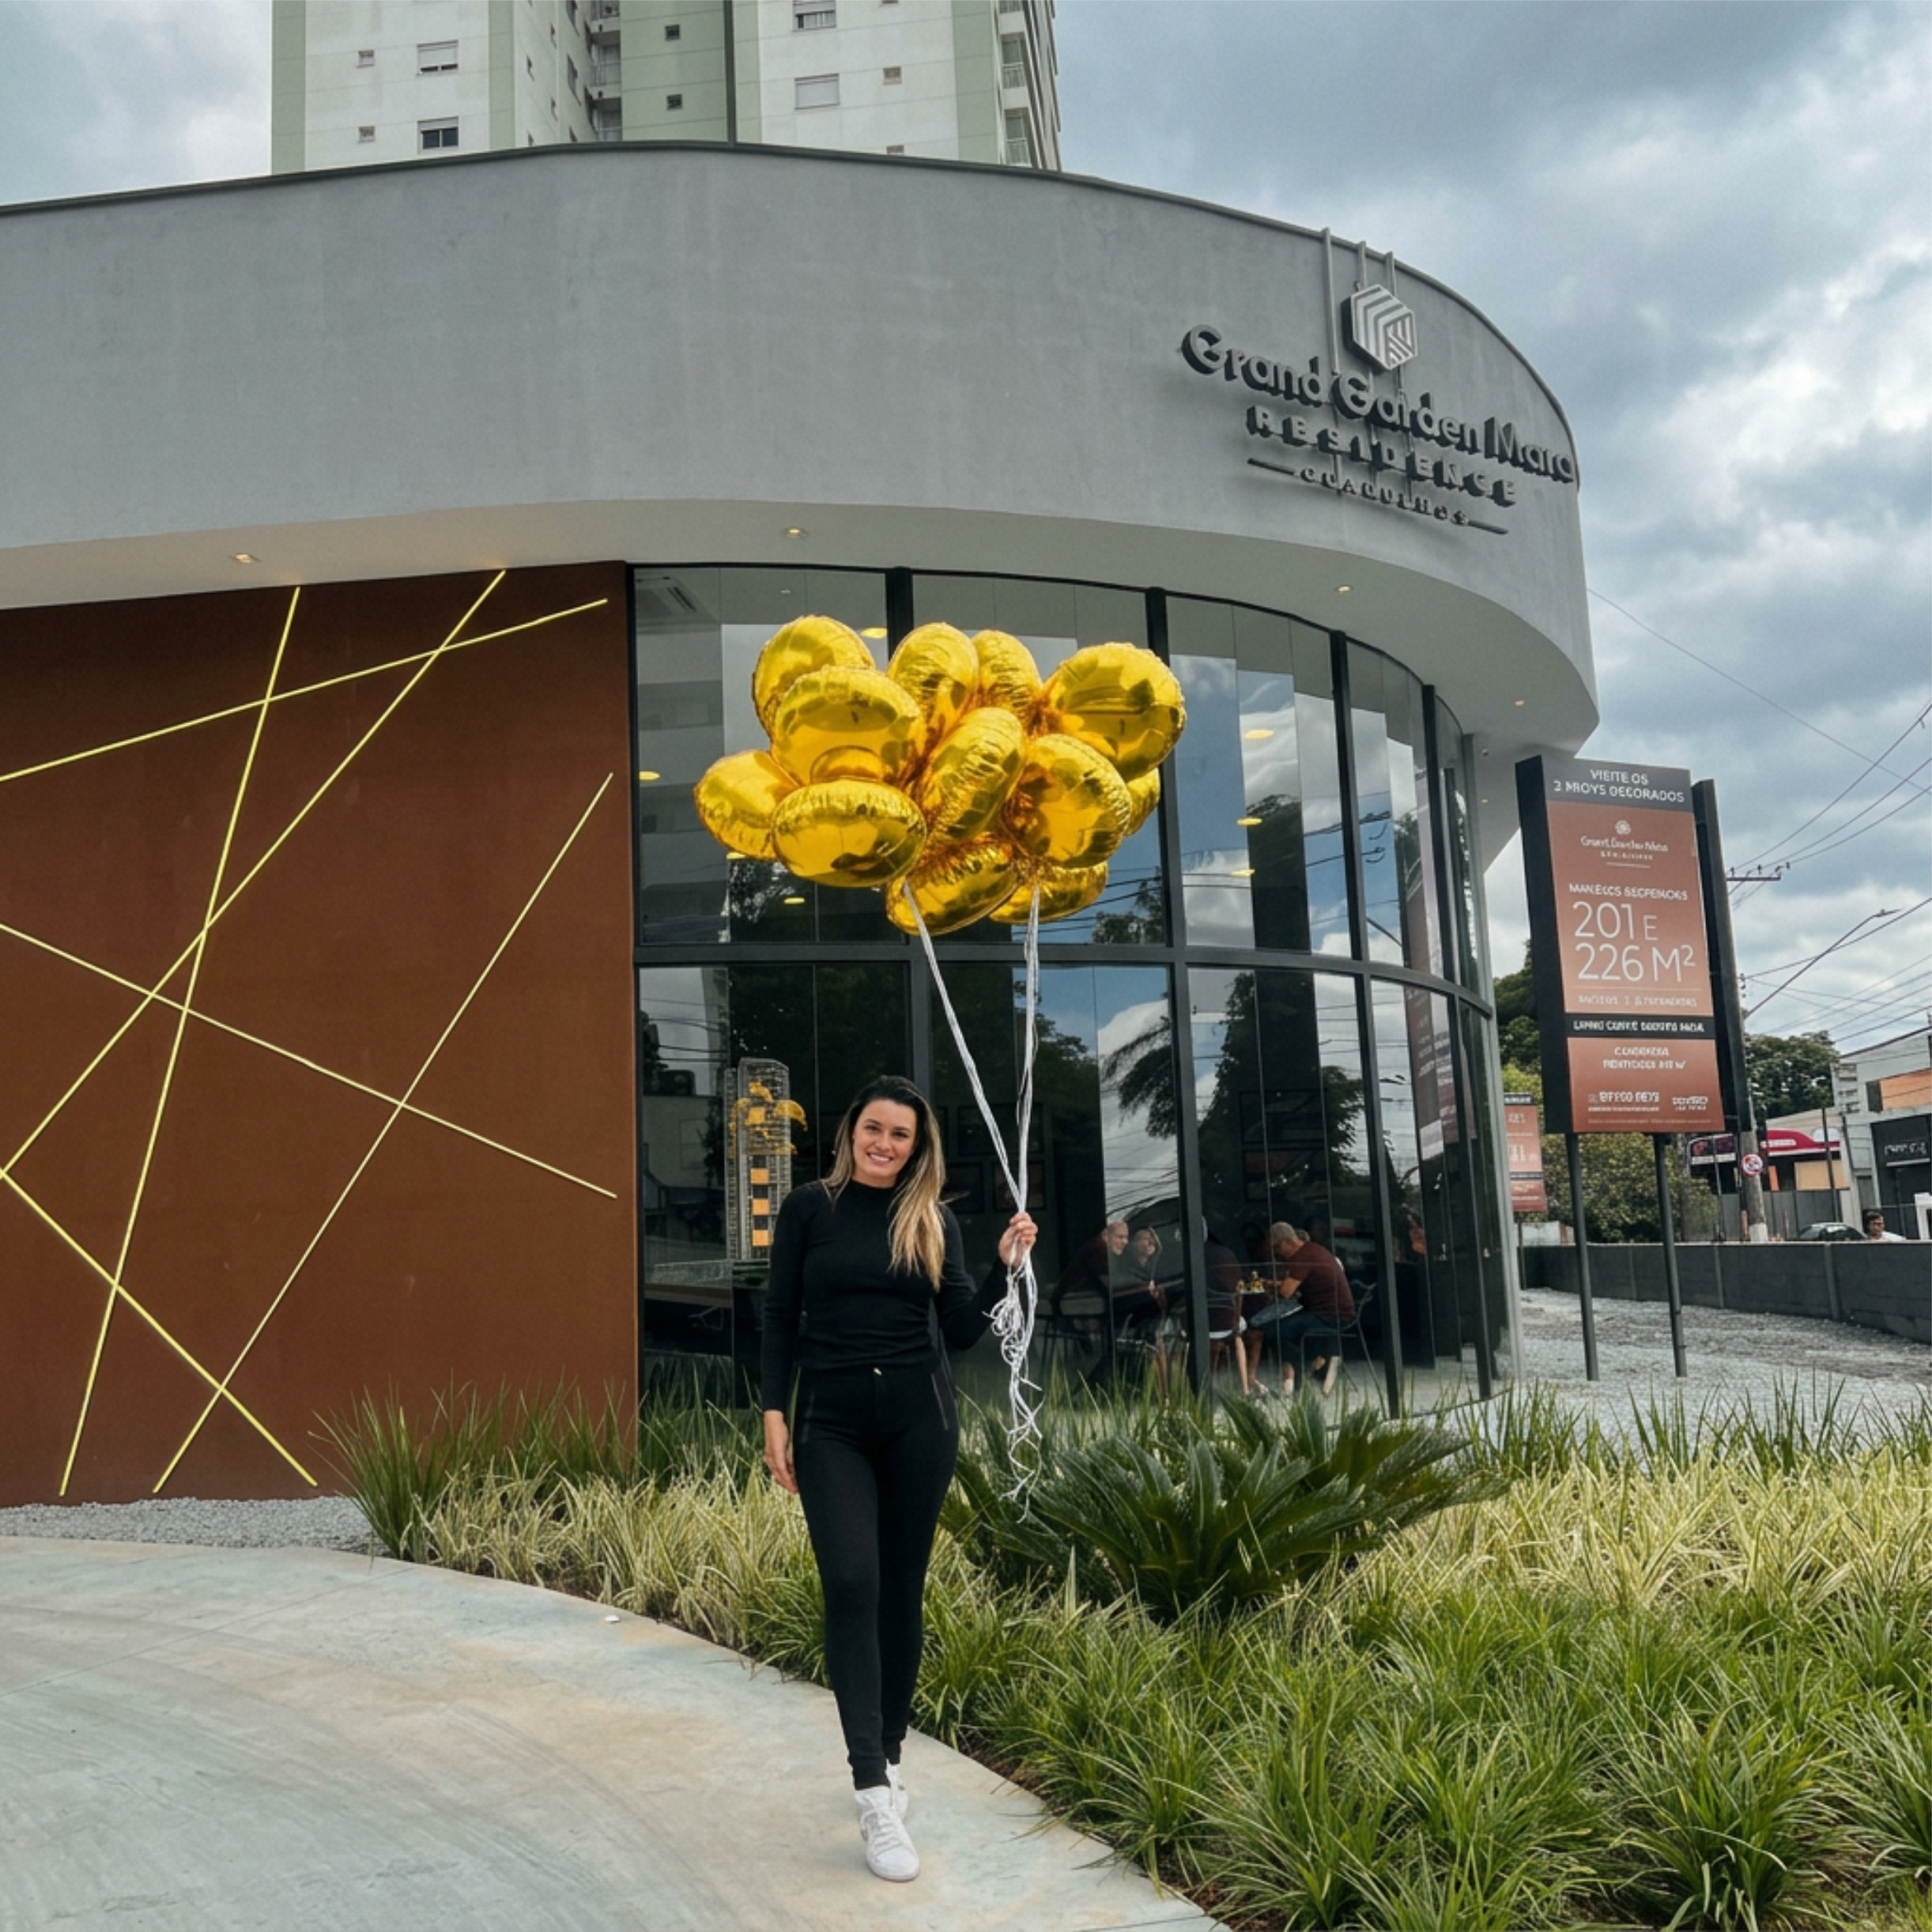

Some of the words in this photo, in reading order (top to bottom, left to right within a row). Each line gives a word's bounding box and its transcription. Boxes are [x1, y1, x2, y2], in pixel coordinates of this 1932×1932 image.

[1181, 324, 1331, 408] Grand
[1330, 370, 1481, 454] Garden
[1572, 900, 1635, 940] 201
[1643, 914, 1659, 940] E
[1574, 942, 1644, 982] 226
